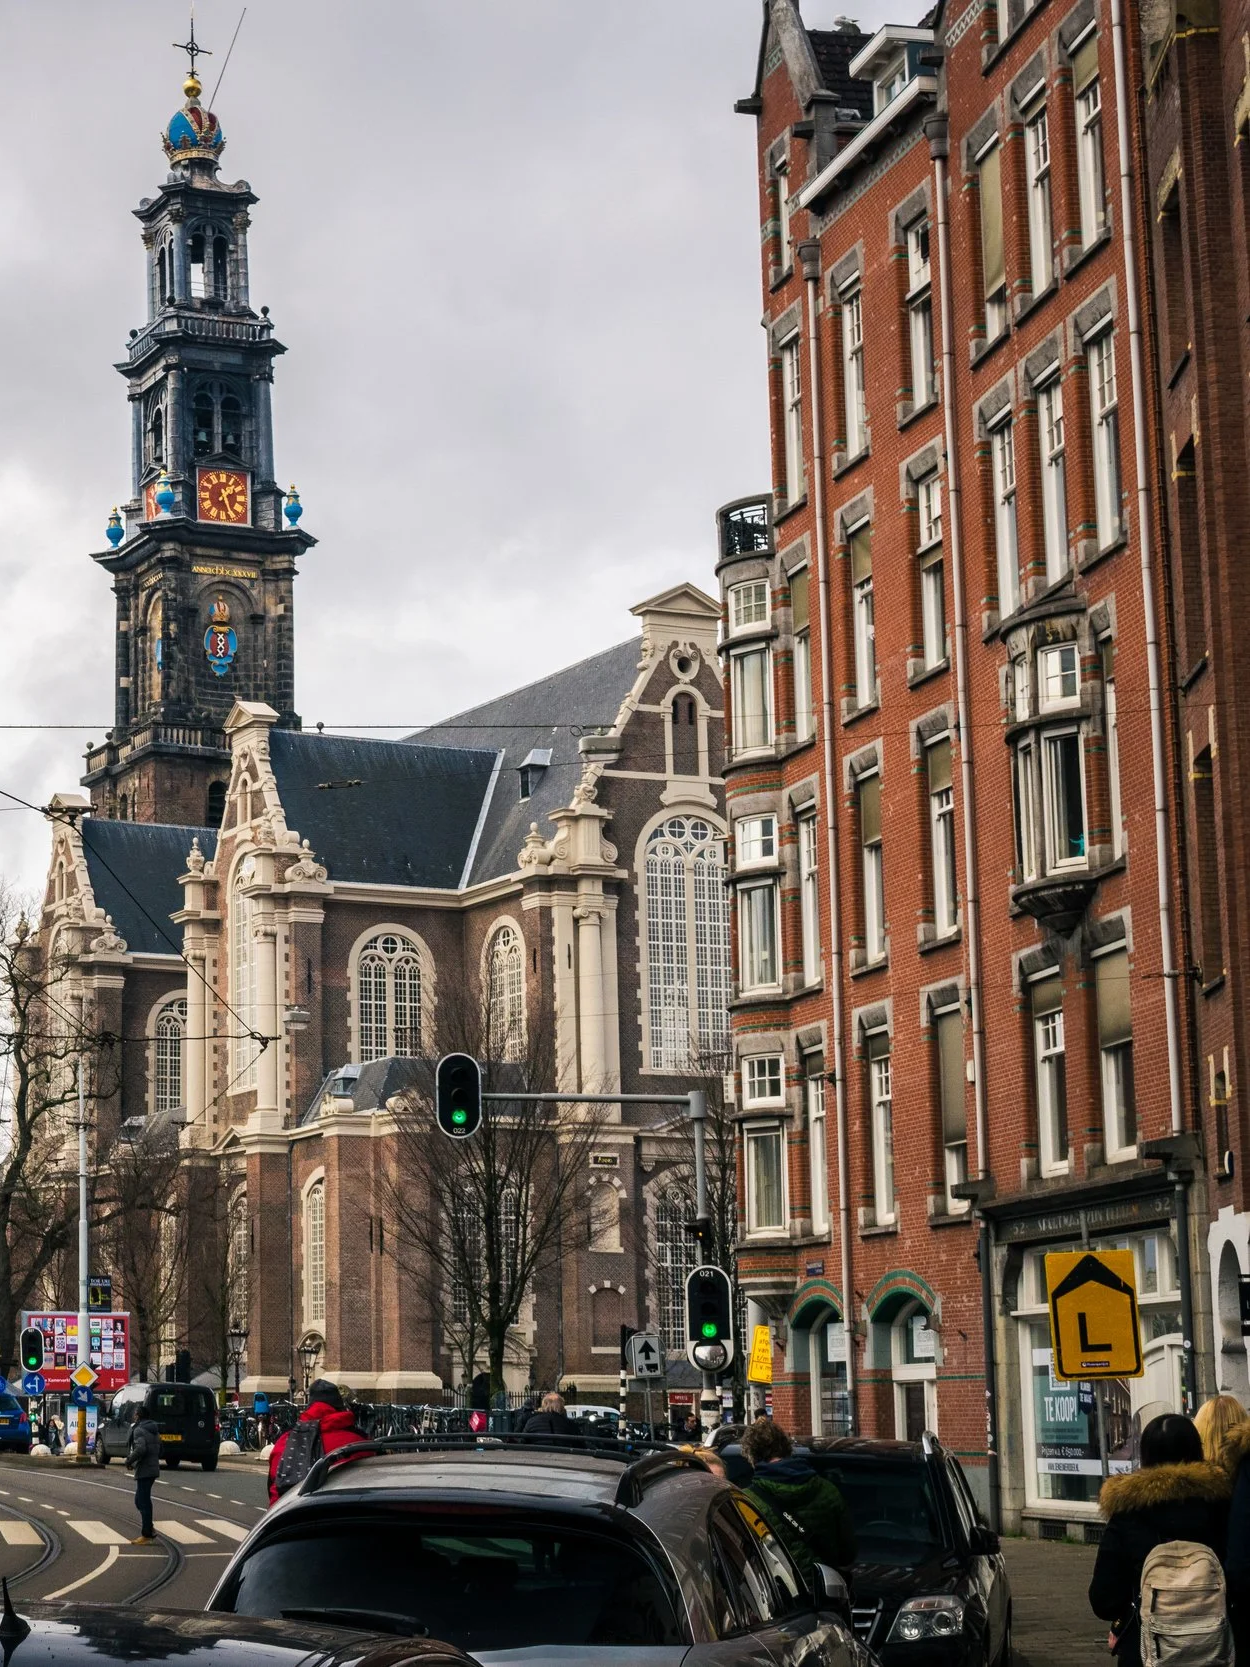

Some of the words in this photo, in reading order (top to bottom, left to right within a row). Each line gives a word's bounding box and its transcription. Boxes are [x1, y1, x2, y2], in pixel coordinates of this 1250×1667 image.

[1154, 1197, 1170, 1212] 52
[1078, 1312, 1112, 1353] L
[1044, 1396, 1054, 1422] TE
[1055, 1396, 1078, 1422] KOOP!
